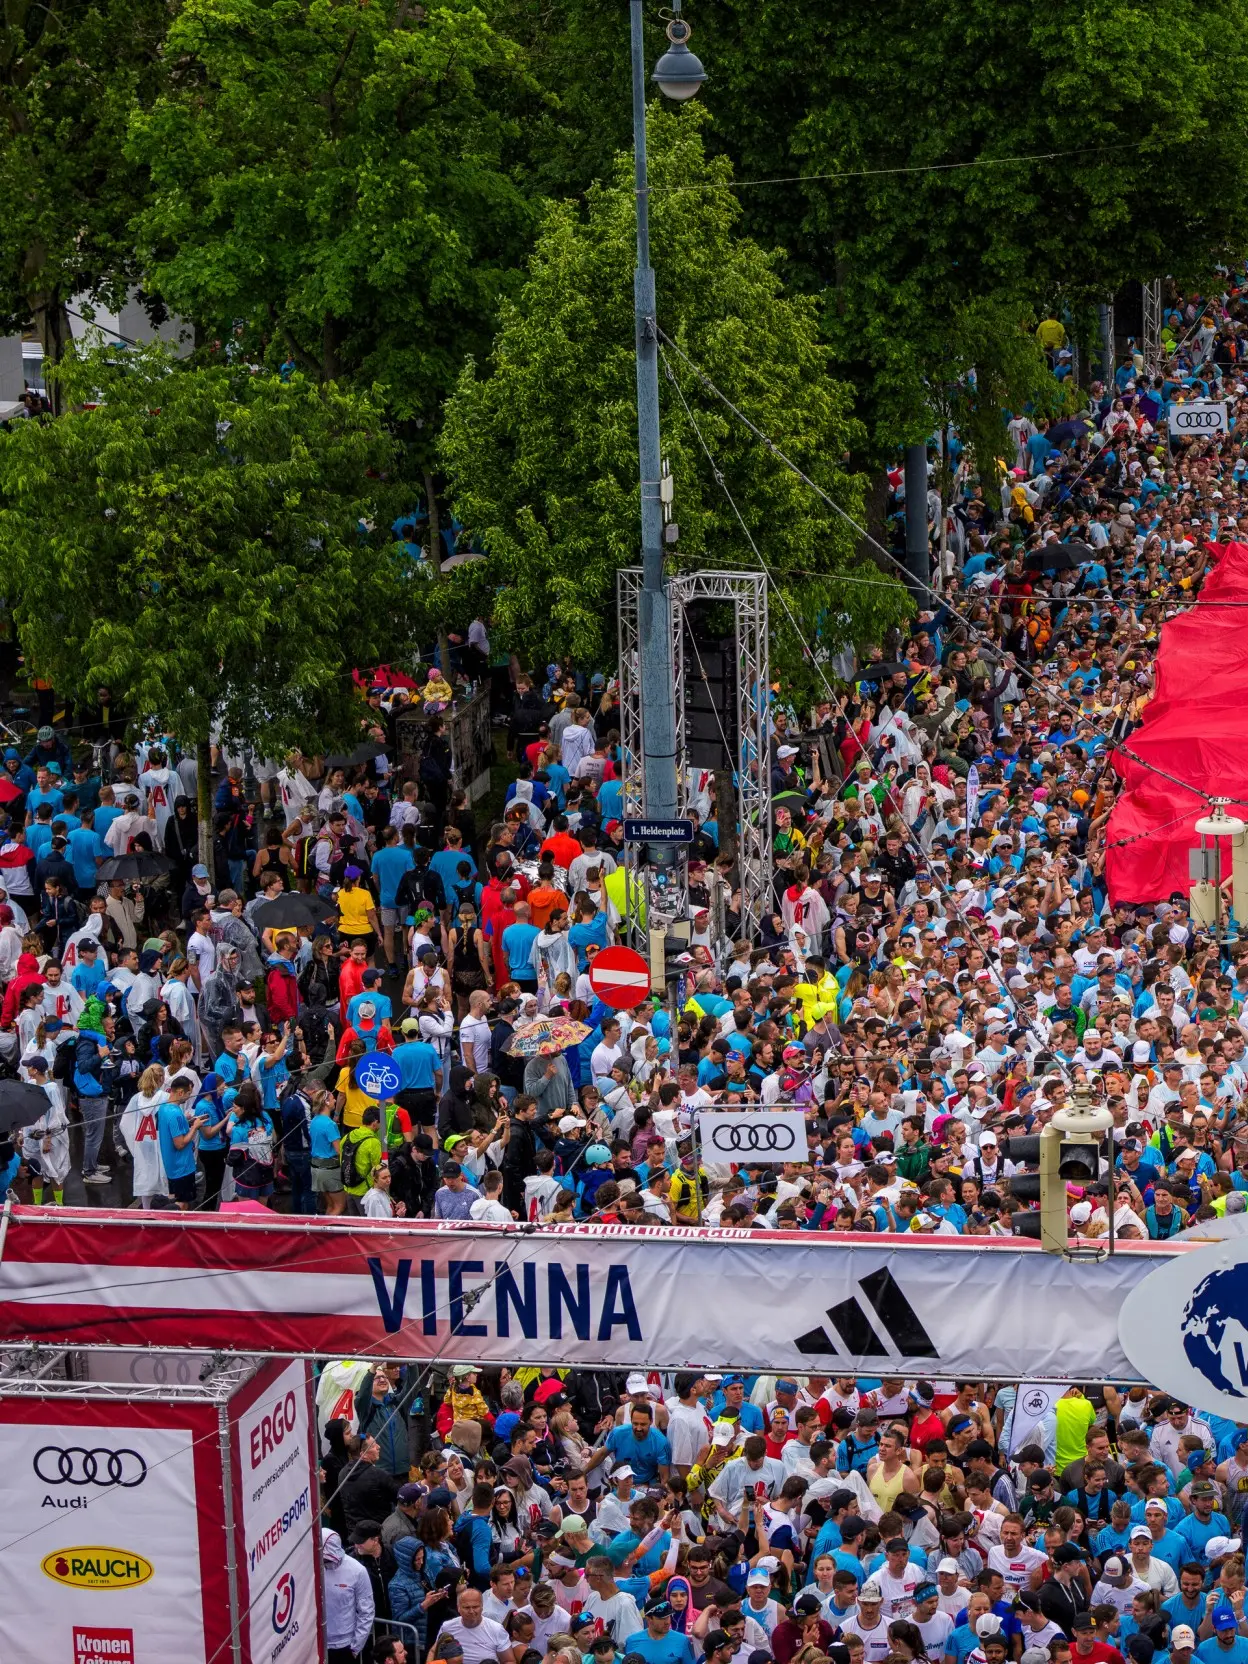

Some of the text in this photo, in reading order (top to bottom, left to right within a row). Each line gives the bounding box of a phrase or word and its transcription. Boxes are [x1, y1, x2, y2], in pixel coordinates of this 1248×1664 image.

[632, 826, 685, 838] 1. Heldenplatz
[367, 1257, 643, 1341] VIENNA
[251, 1390, 296, 1470] ERGO
[252, 1446, 299, 1502] ergo-versicherung.at
[41, 1495, 88, 1508] Audi
[256, 1487, 309, 1563] INTERSPORT
[71, 1558, 140, 1579] RAUCH
[1005, 1575, 1026, 1584] allwyn
[76, 1634, 130, 1654] Kronen
